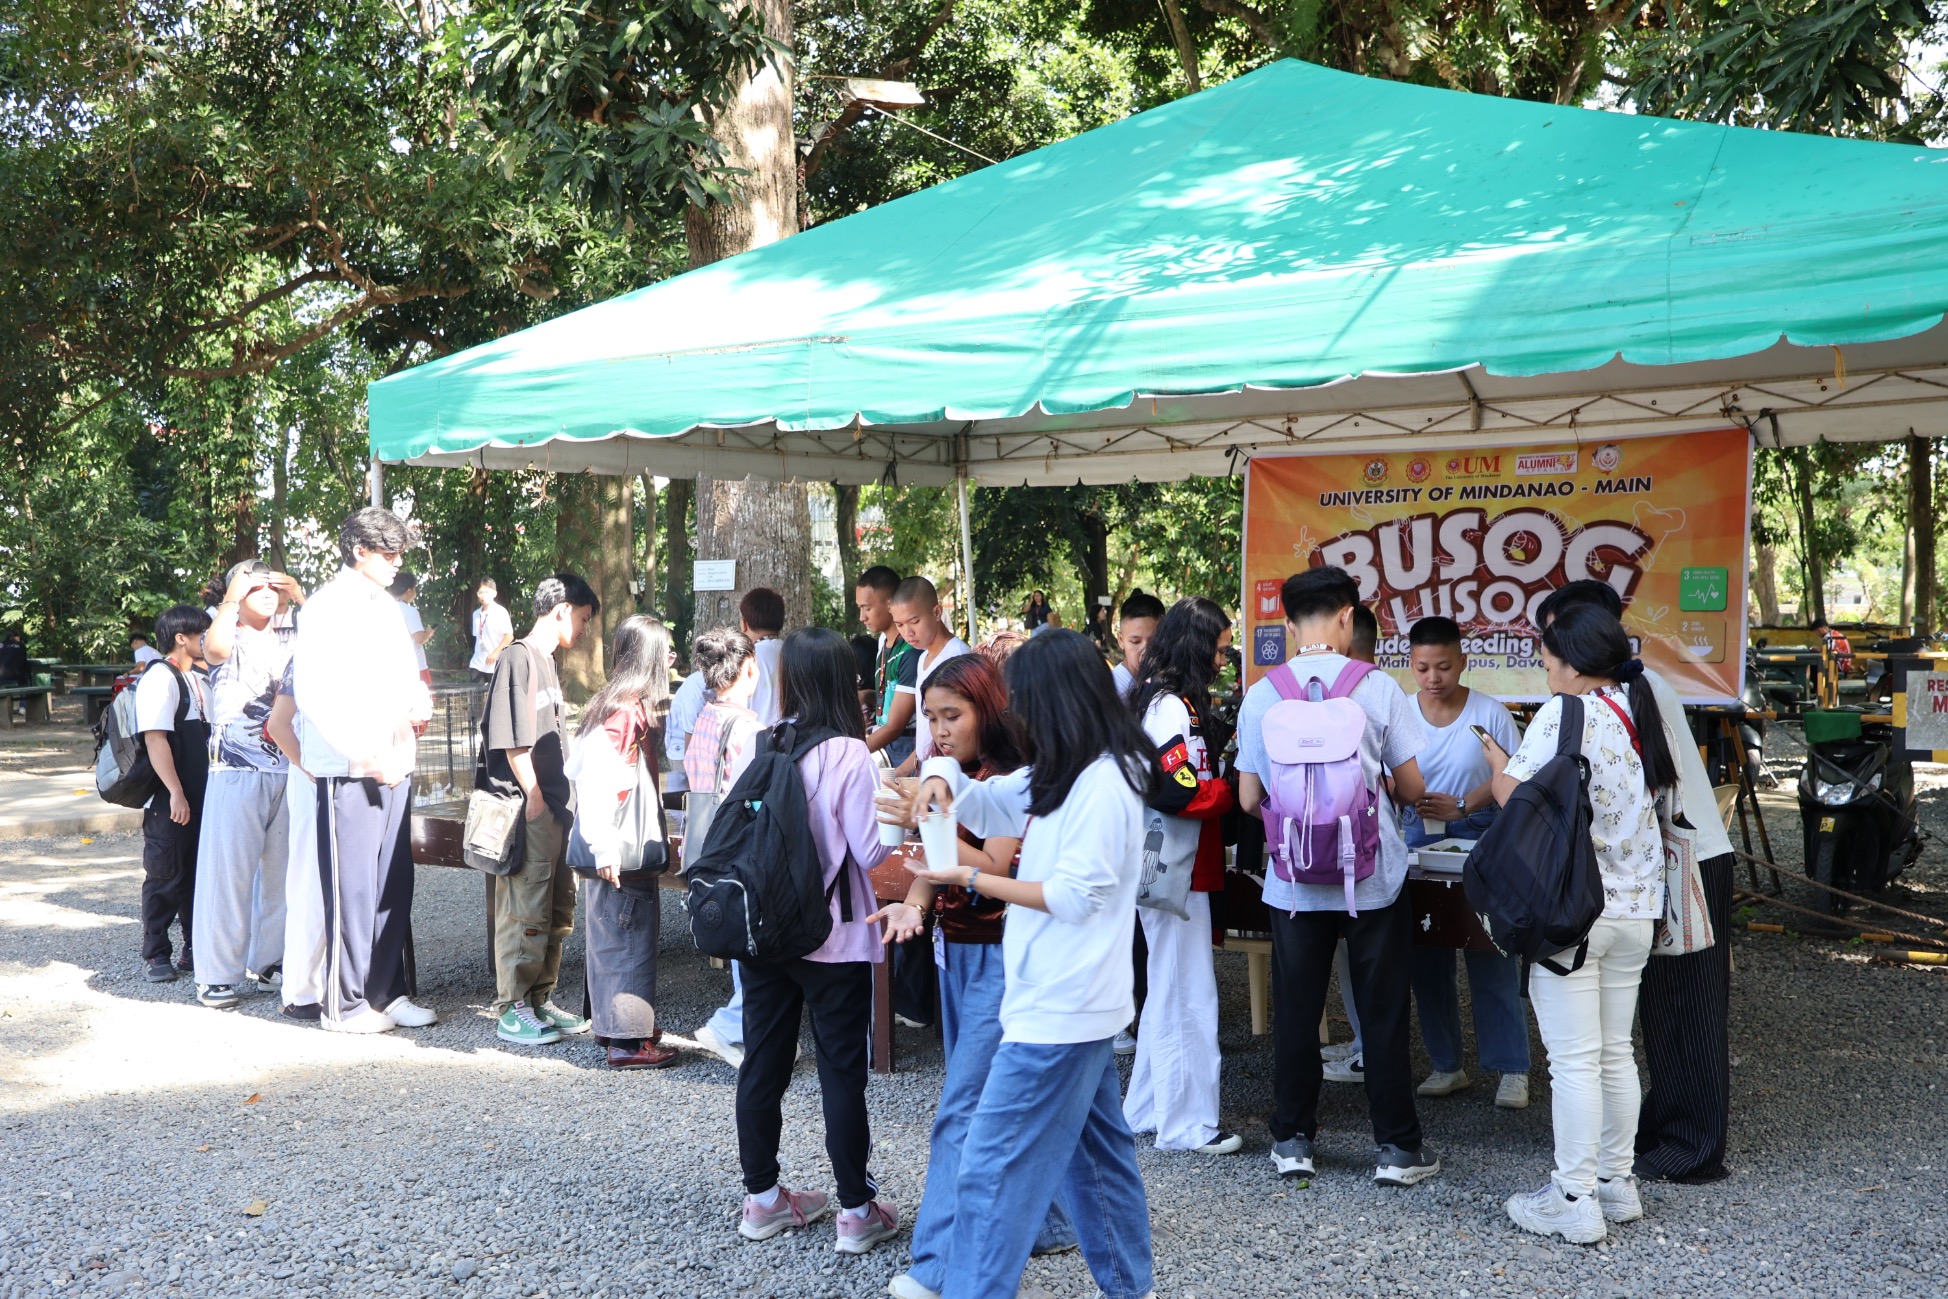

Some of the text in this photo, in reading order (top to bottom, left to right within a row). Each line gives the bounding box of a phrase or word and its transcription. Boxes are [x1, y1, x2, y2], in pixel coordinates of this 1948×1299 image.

[1464, 456, 1501, 474] UM
[1518, 458, 1556, 469] ALUMNI
[1320, 487, 1423, 507] UNIVERSITY
[1428, 486, 1453, 502] OF
[1459, 481, 1574, 500] MINDANAO
[1594, 476, 1652, 495] MAIN
[1321, 510, 1648, 601] BUSOG
[1684, 570, 1690, 580] 3
[1256, 583, 1261, 592] 4
[1256, 628, 1263, 638] 17
[1682, 621, 1688, 632] 2
[1460, 633, 1533, 657] eeding
[1378, 655, 1410, 668] Mati
[1468, 657, 1501, 671] pus,
[1166, 749, 1182, 766] F-1
